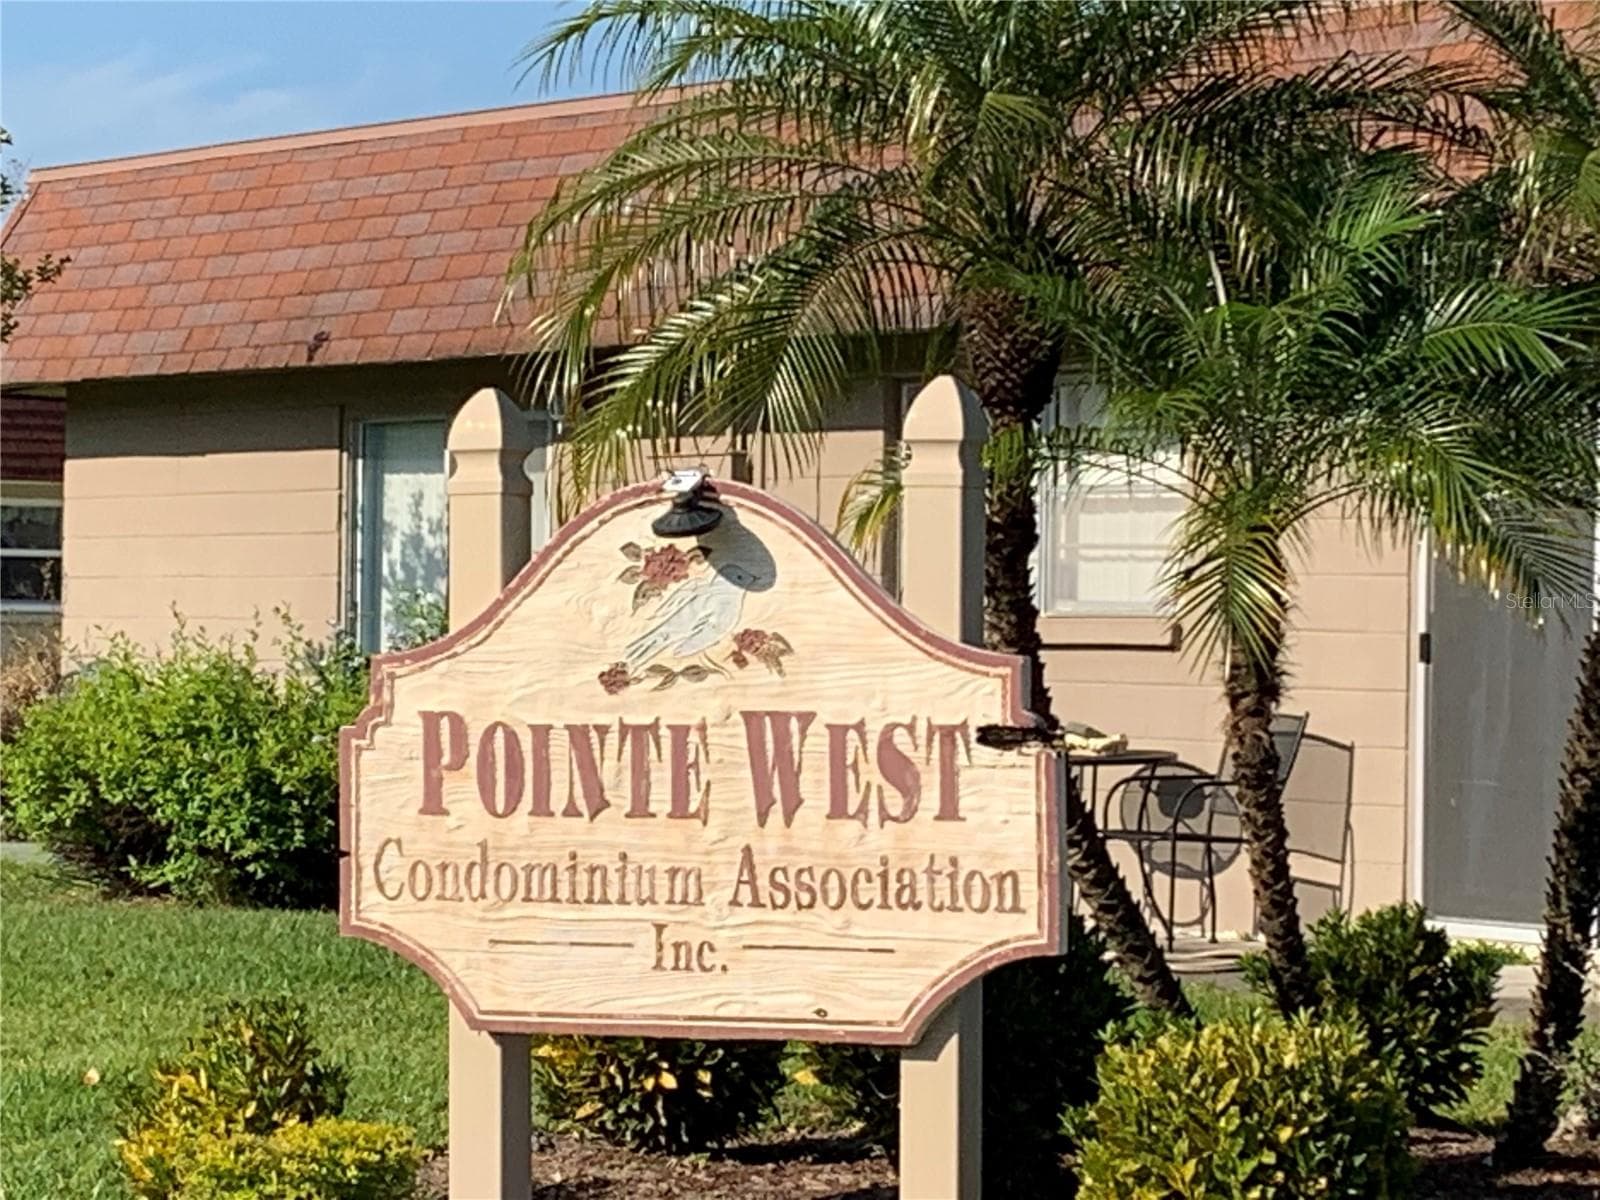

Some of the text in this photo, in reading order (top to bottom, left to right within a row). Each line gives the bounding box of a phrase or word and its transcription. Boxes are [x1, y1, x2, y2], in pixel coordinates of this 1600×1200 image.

[418, 710, 973, 829] POINTE WEST
[373, 837, 1027, 915] Condominium Association
[650, 922, 729, 974] Inc.
